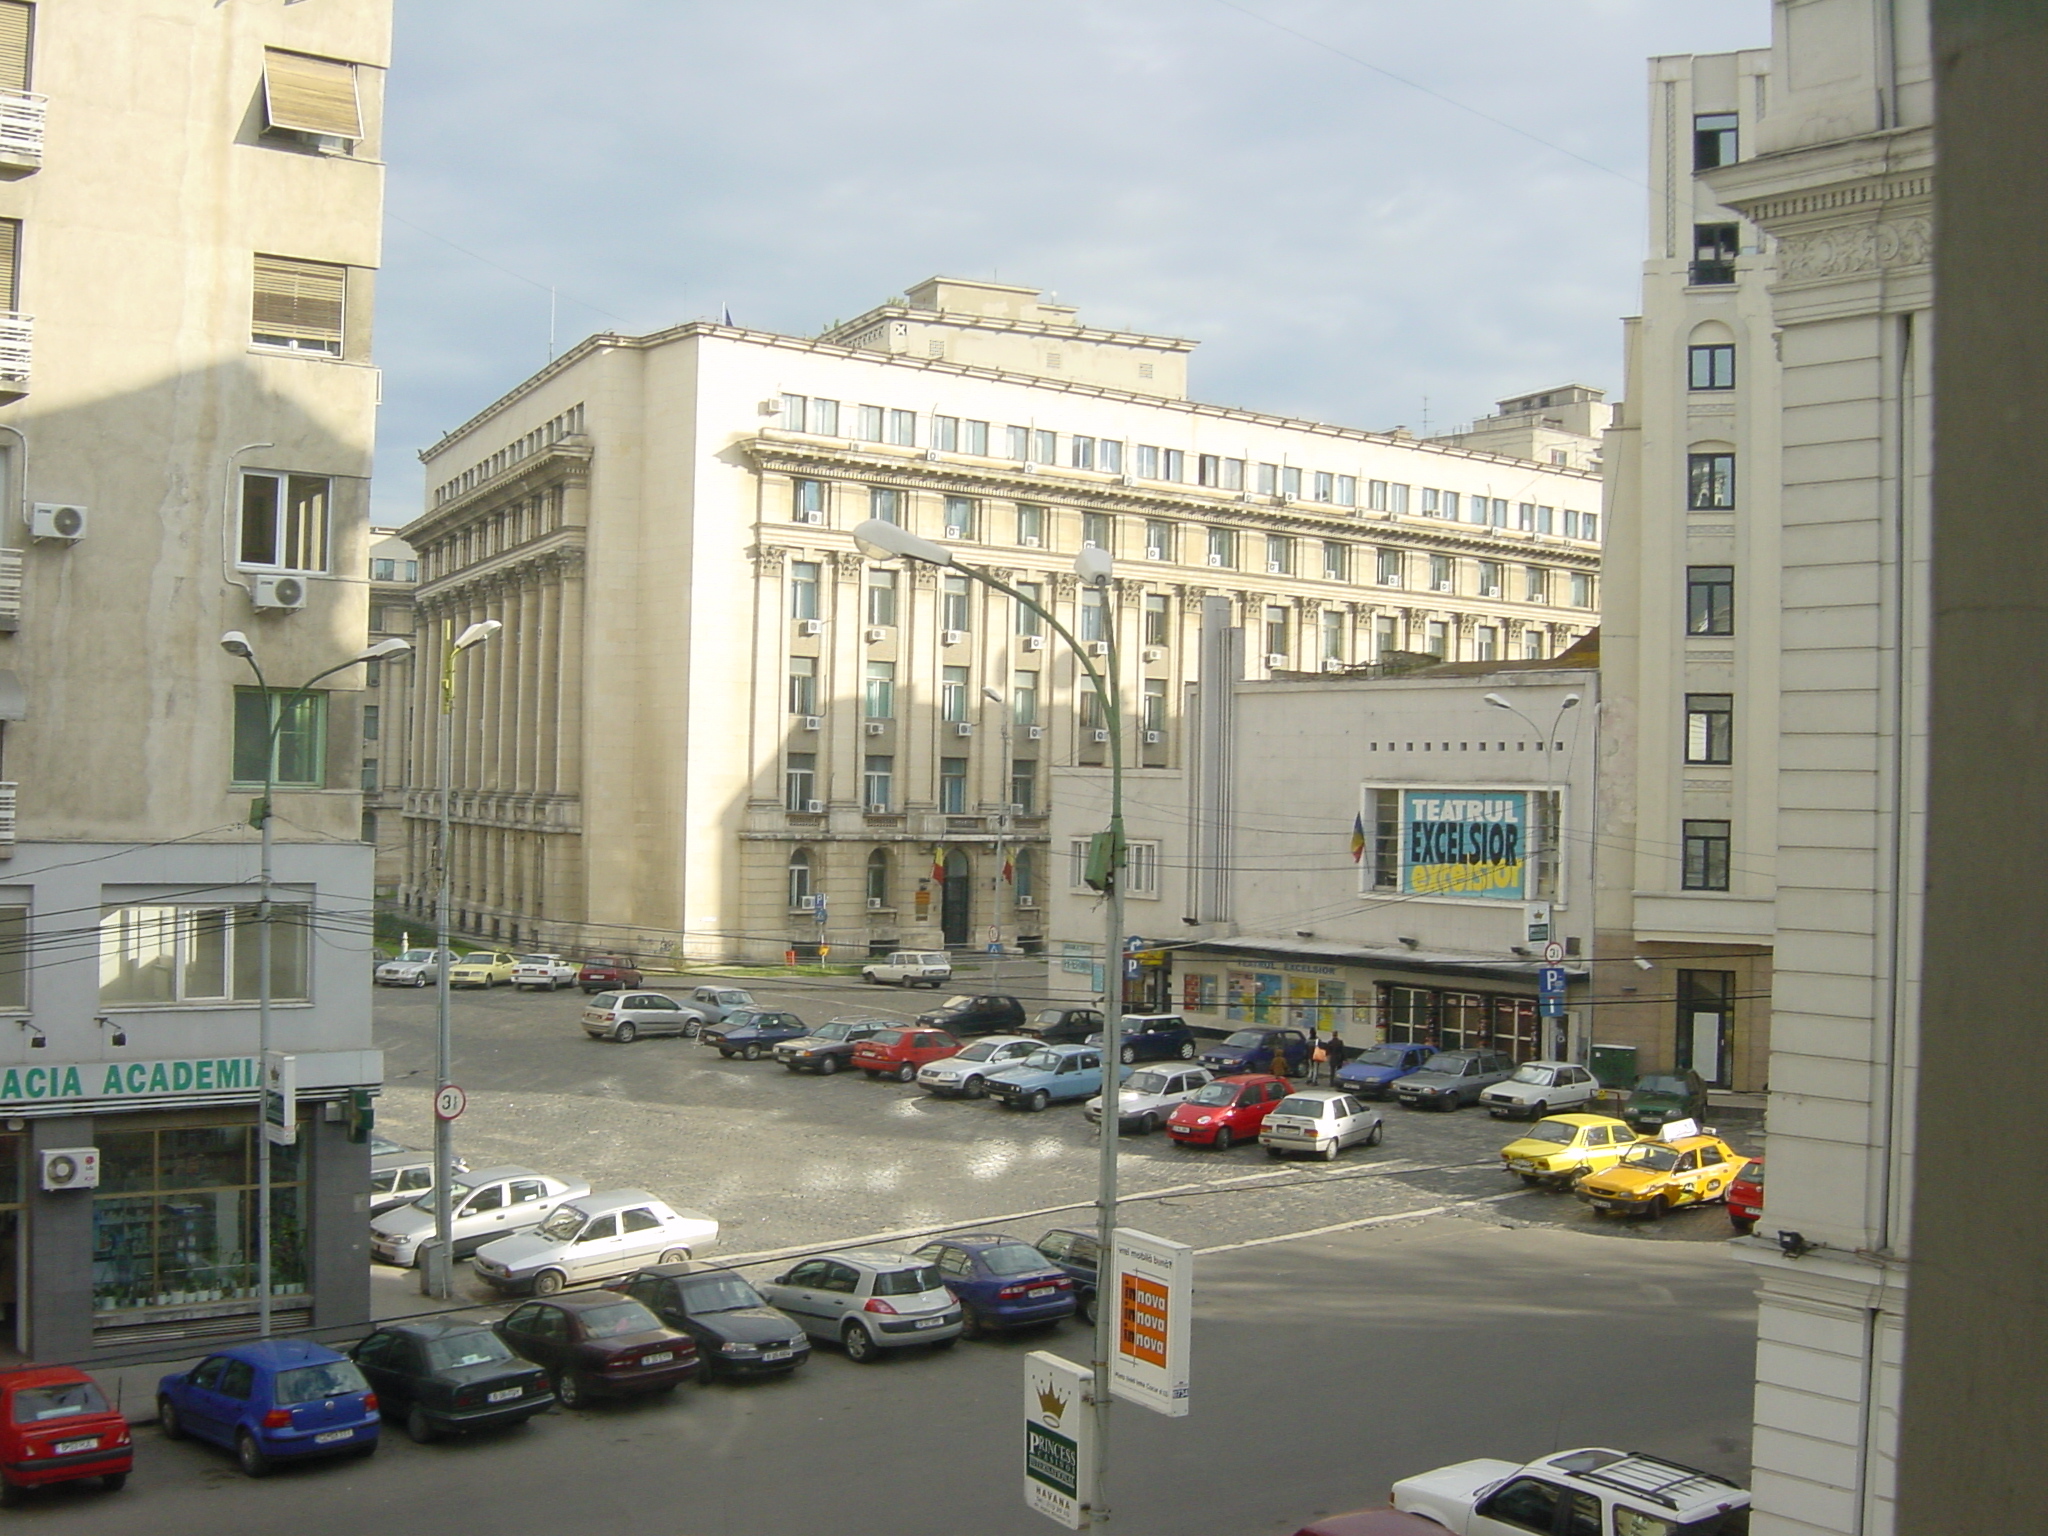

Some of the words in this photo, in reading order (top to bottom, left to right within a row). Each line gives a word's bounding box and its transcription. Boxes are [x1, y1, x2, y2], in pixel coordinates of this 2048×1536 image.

[1412, 799, 1518, 823] TEATRUL
[1411, 821, 1518, 867] EXCELSIOR
[1411, 858, 1523, 893] excelsior
[1546, 970, 1558, 991] P
[0, 1066, 83, 1099] ACIA
[1028, 1431, 1076, 1467] PRINCESS
[1036, 1484, 1070, 1510] HAVANA
